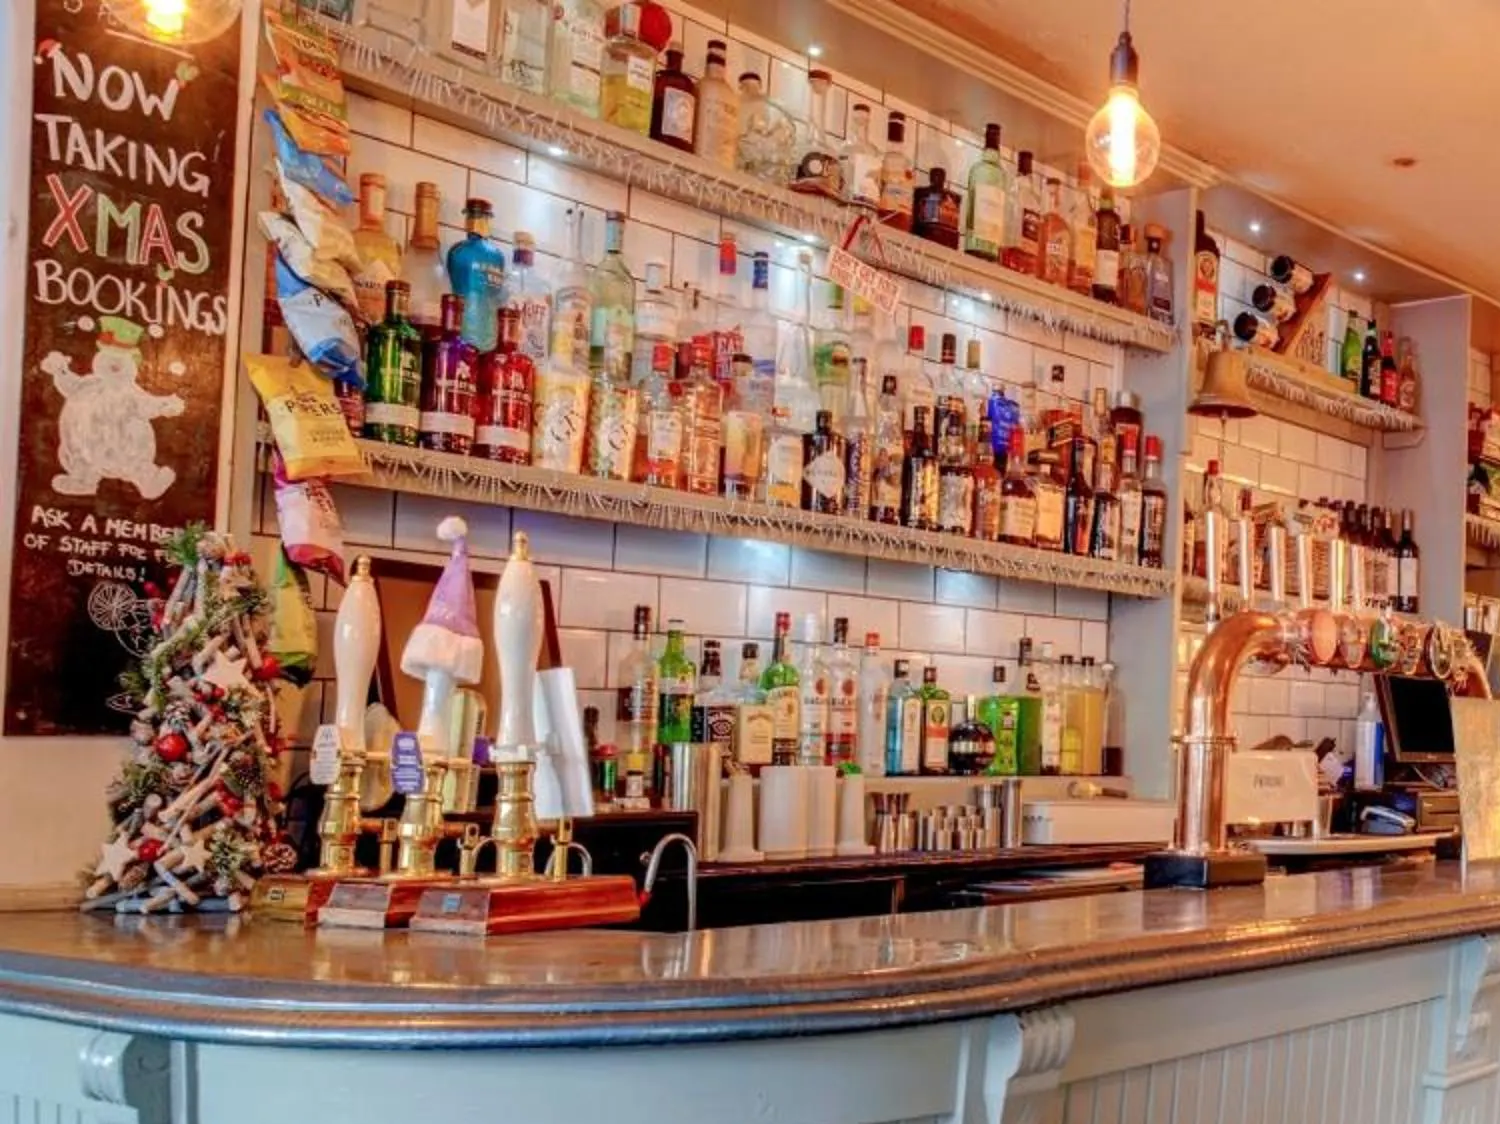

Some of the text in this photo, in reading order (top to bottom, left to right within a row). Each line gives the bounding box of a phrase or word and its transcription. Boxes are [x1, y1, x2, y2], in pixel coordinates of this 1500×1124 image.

[50, 50, 180, 121] NOW
[34, 113, 211, 197] TAKING
[42, 173, 210, 274] XMAS
[33, 259, 228, 336] BOOKINGS
[23, 532, 51, 551] OF
[59, 535, 113, 557] STAFF
[31, 505, 72, 530] ASK
[80, 514, 98, 535] A
